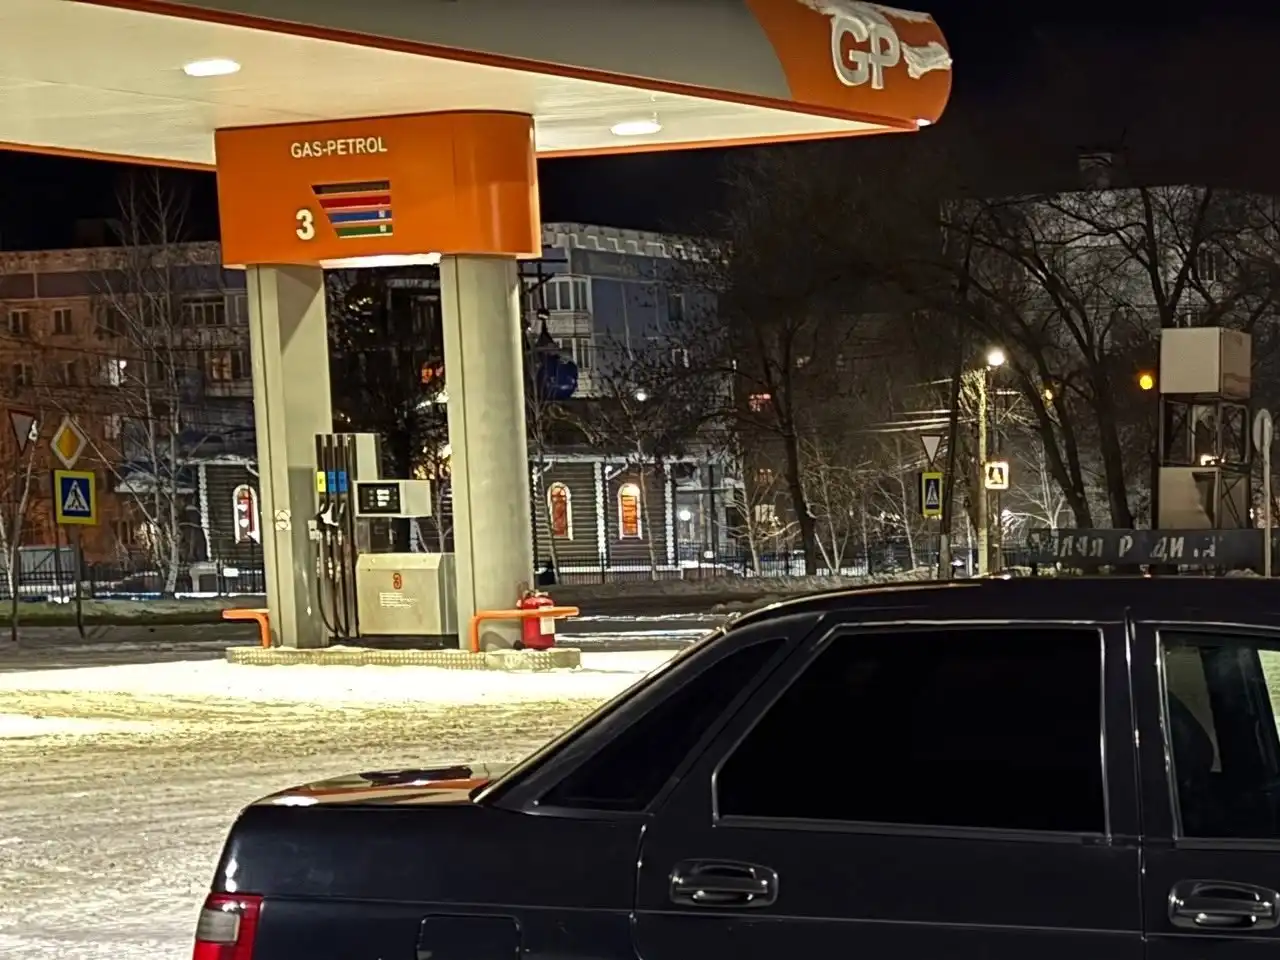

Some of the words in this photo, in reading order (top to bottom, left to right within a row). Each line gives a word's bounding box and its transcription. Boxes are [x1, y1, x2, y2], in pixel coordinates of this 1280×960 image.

[831, 16, 900, 89] GP
[291, 136, 388, 158] GAS-PETROL
[295, 209, 315, 240] 3
